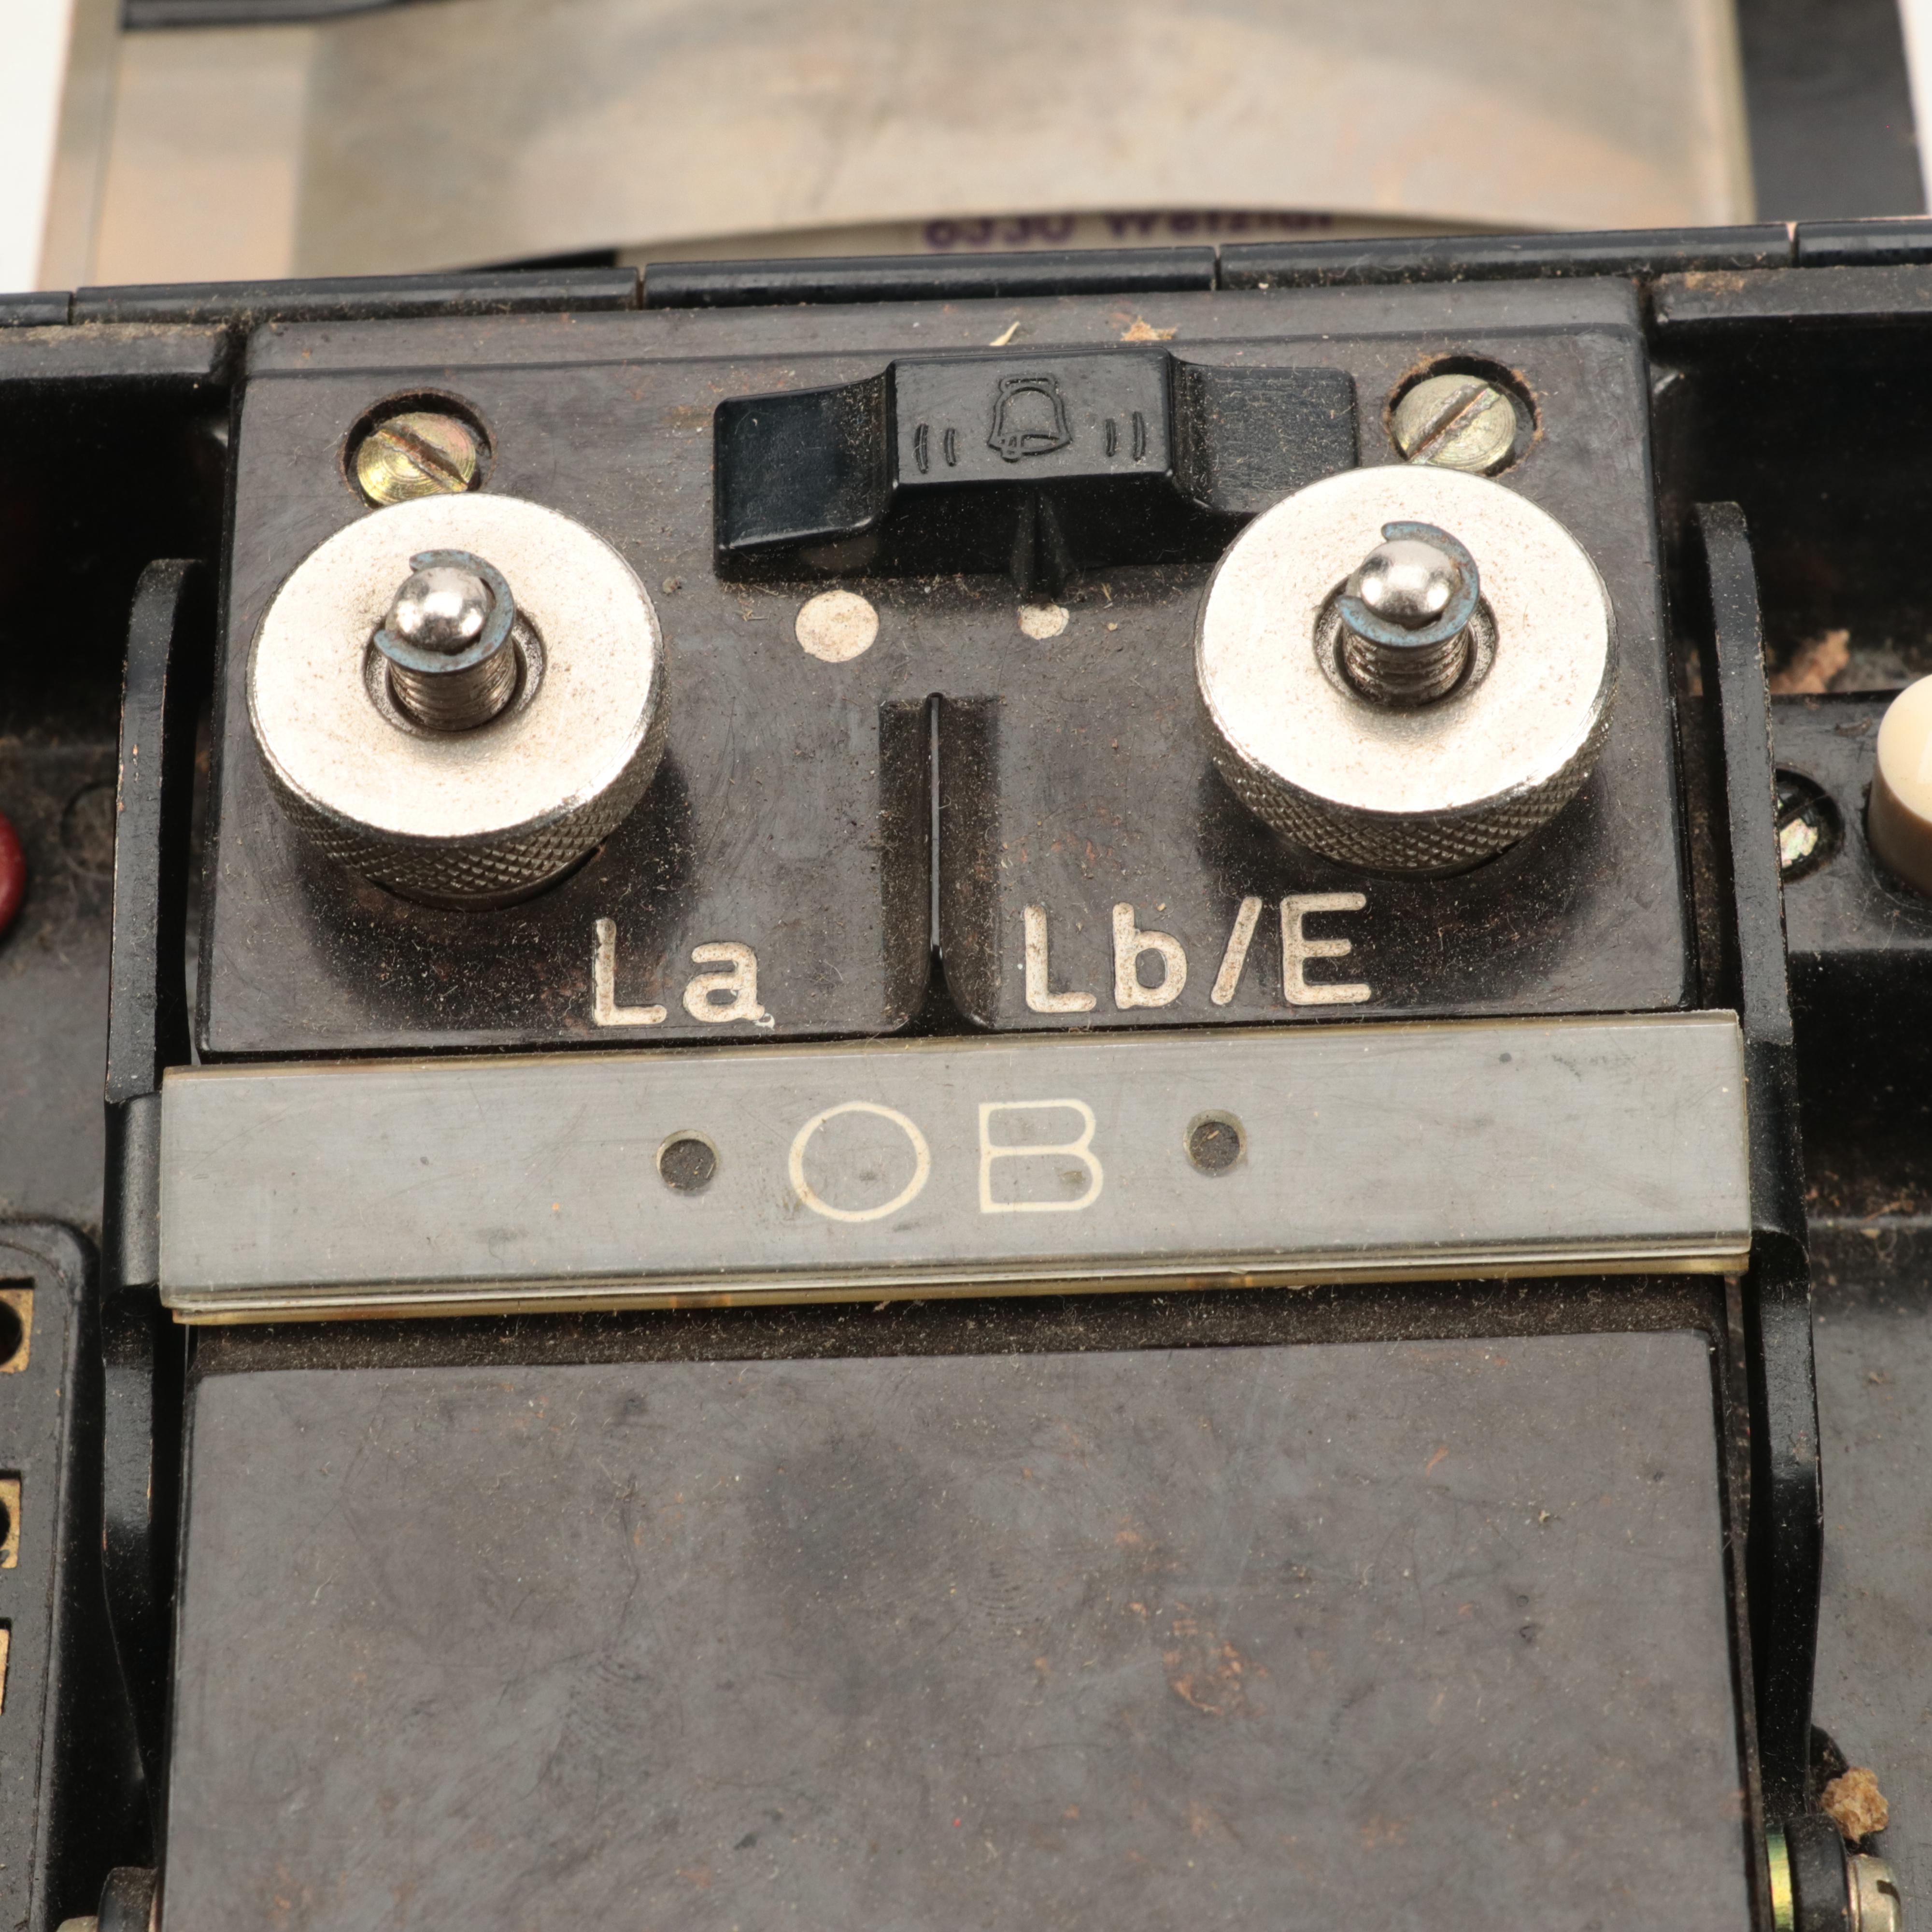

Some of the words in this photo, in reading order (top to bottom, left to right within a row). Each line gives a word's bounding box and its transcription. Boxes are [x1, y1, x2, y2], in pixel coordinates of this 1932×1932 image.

[593, 917, 766, 1025] La
[1024, 892, 1371, 1012] Lb/E
[788, 1098, 1104, 1222] OB
